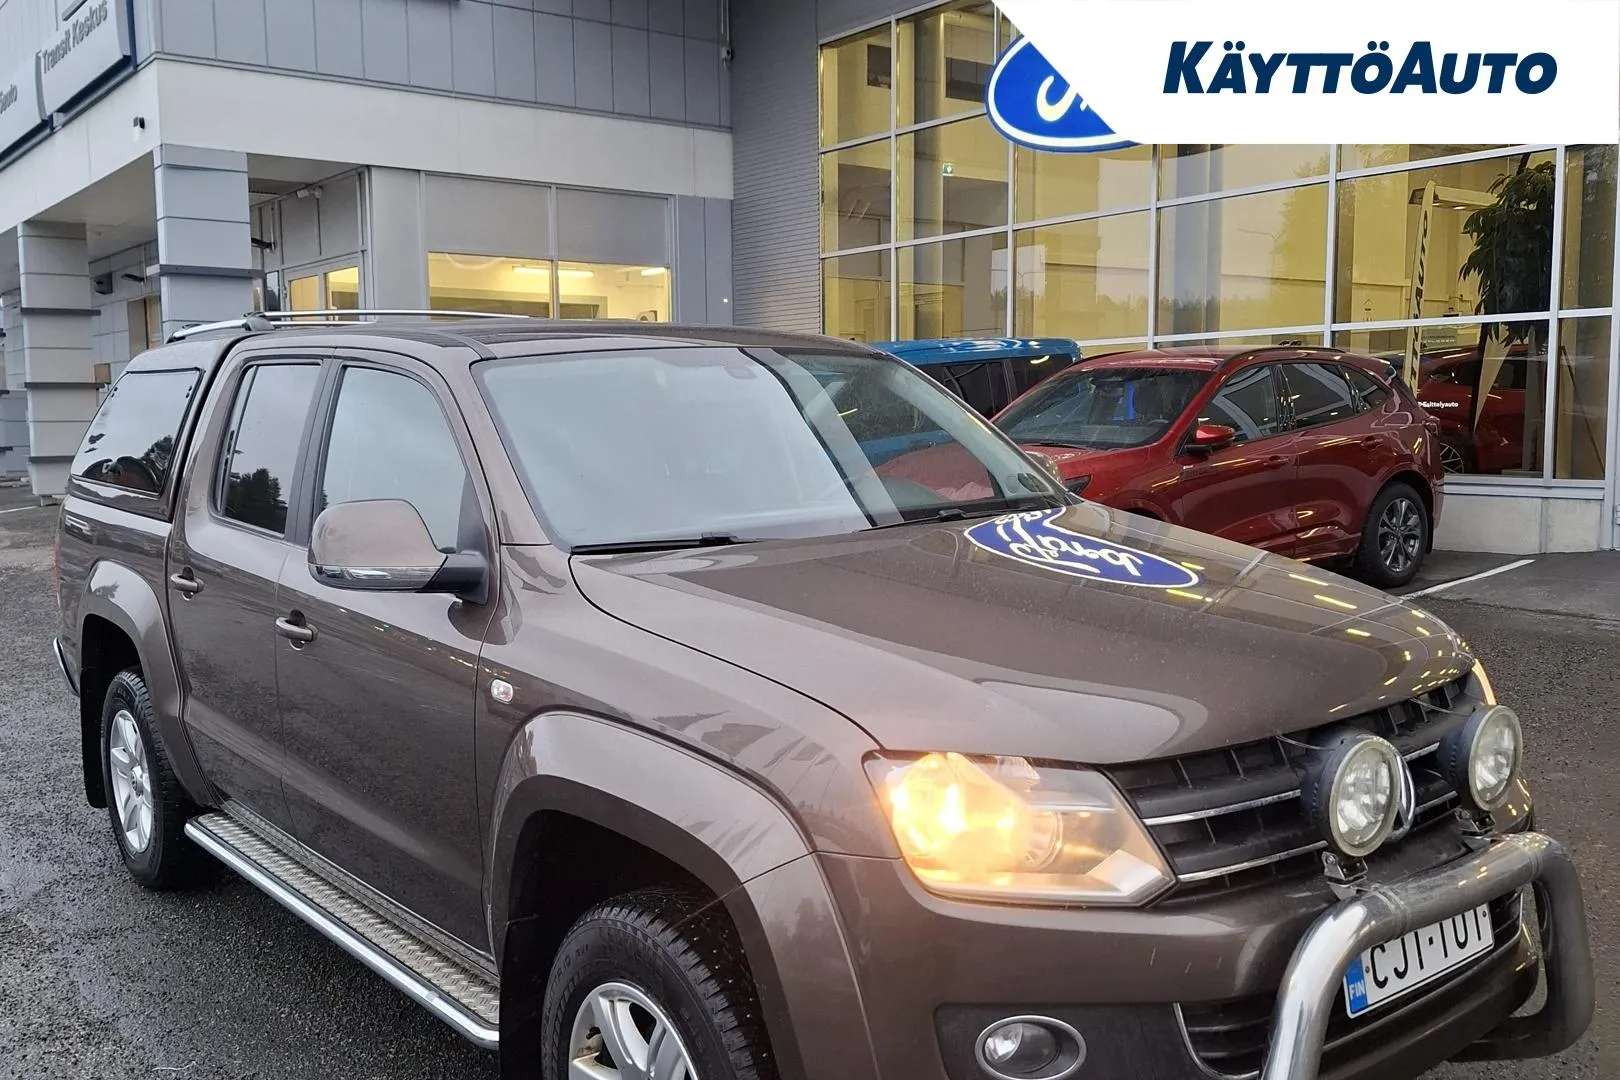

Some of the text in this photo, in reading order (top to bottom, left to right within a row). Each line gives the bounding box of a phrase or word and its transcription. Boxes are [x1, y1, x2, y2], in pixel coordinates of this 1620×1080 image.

[42, 0, 109, 74] Transit Keskus
[1349, 981, 1366, 1000] FIN
